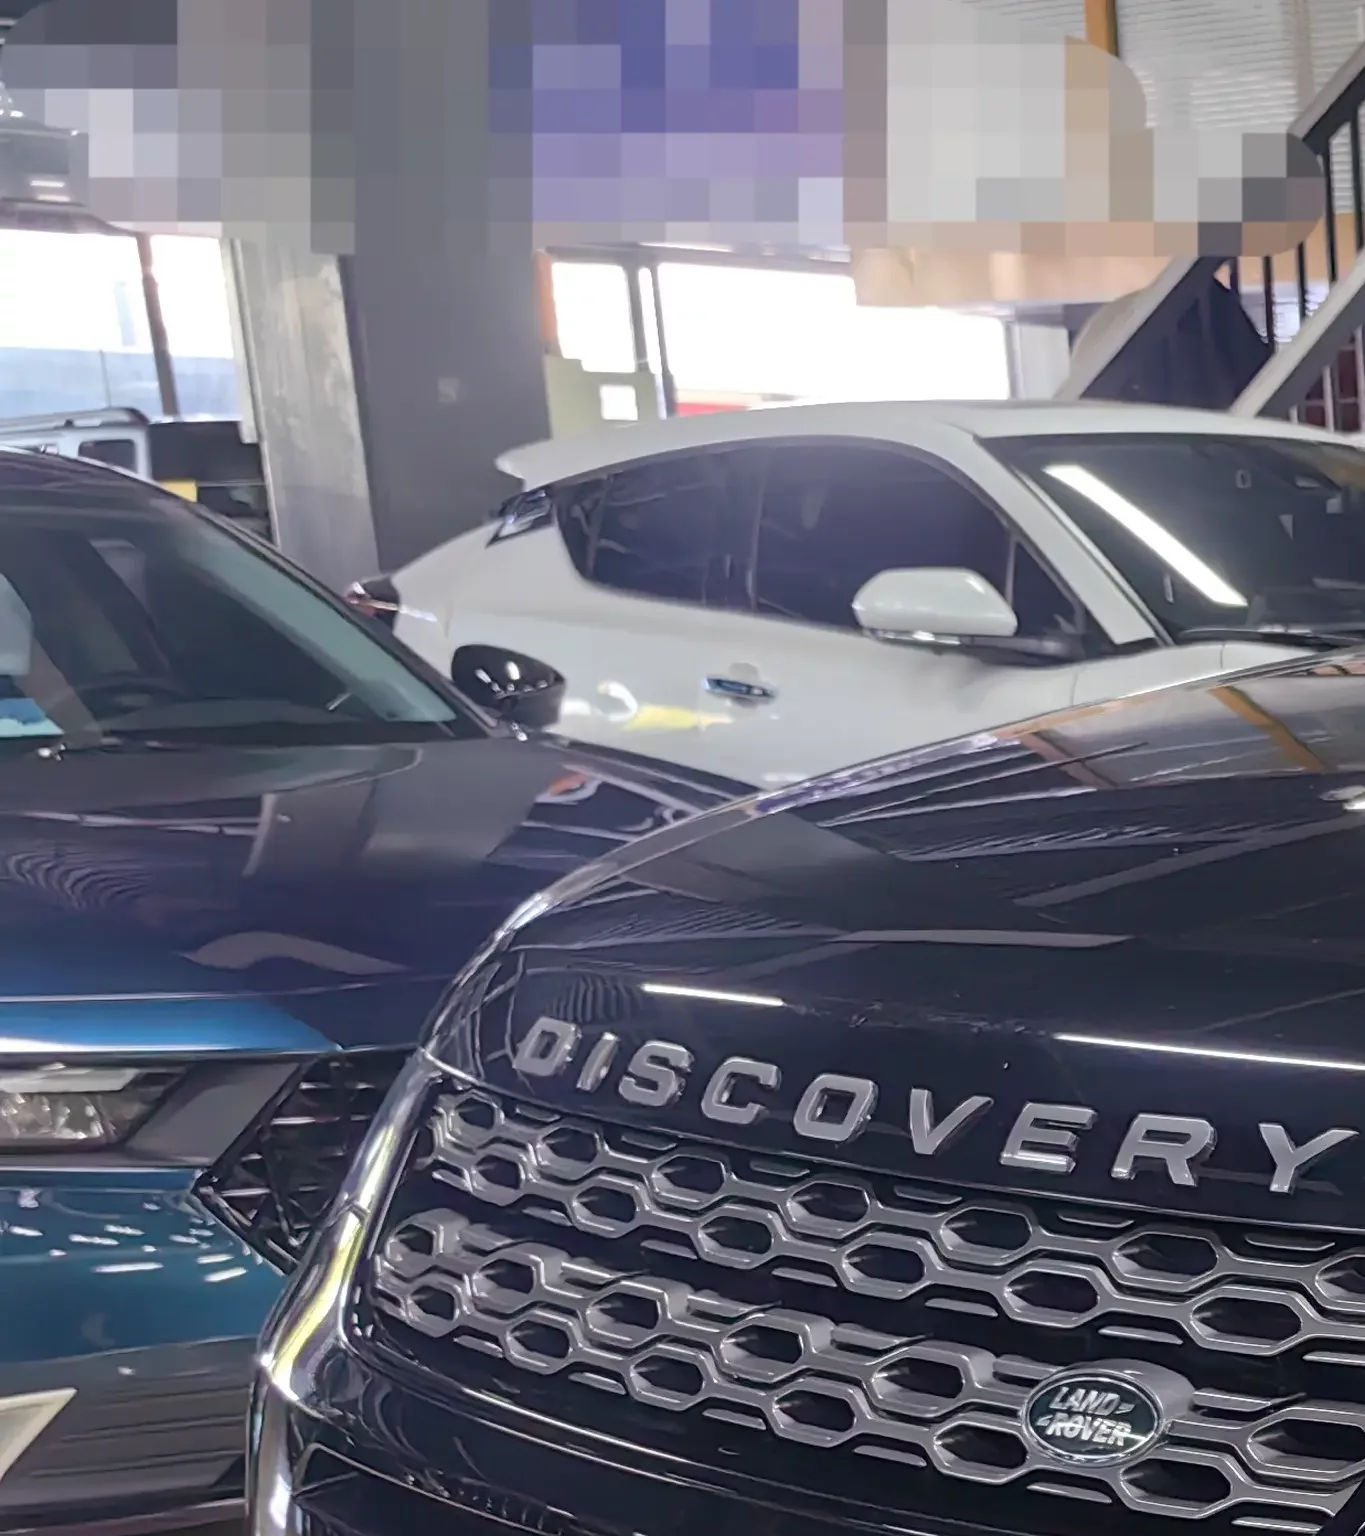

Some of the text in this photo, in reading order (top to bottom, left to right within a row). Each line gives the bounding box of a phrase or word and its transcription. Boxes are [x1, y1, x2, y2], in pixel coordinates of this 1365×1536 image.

[512, 1016, 1361, 1195] DISCOVERY
[1049, 1386, 1130, 1416] LAND
[1044, 1412, 1132, 1446] ROVER
